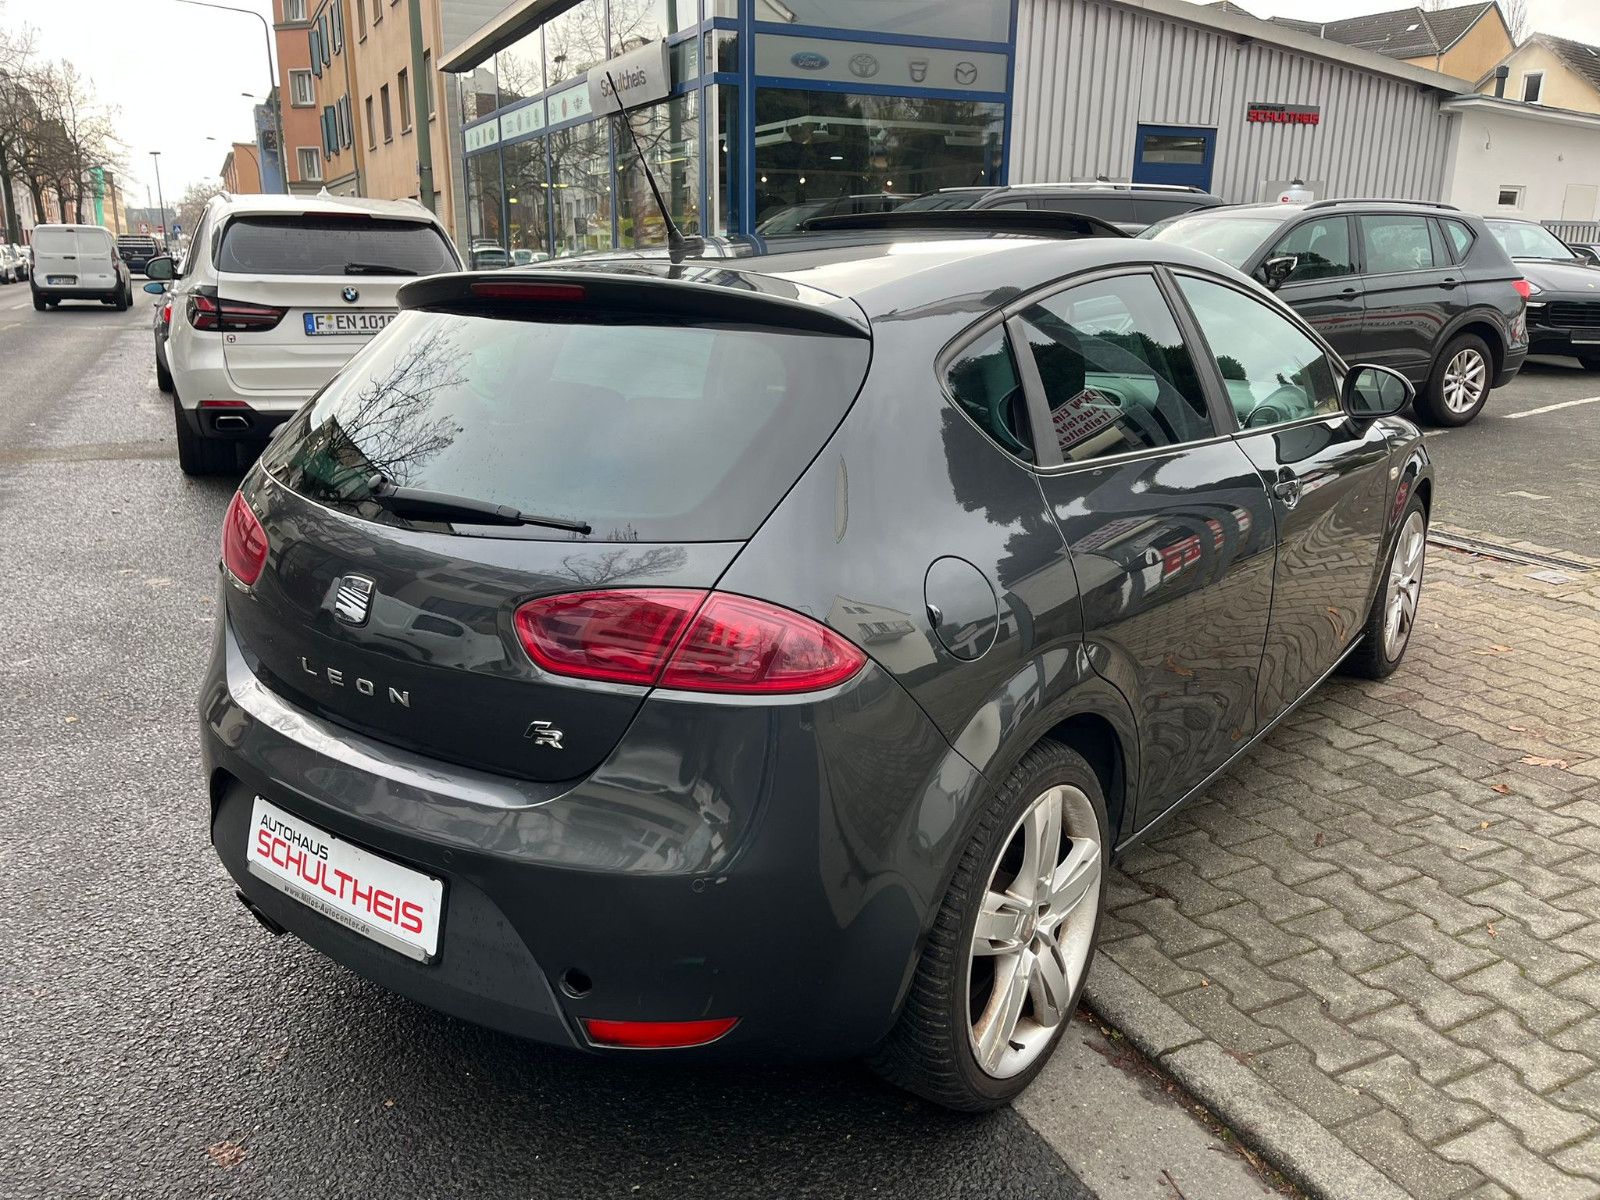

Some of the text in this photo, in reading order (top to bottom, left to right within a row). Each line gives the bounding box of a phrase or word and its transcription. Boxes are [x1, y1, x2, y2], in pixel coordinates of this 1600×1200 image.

[600, 65, 647, 97] Scultheis
[315, 315, 325, 330] F
[336, 315, 357, 329] EN
[301, 656, 410, 708] LEON
[523, 720, 564, 750] FR
[260, 813, 329, 861] AUTOHAUS
[257, 828, 424, 934] SCHULTHEIS
